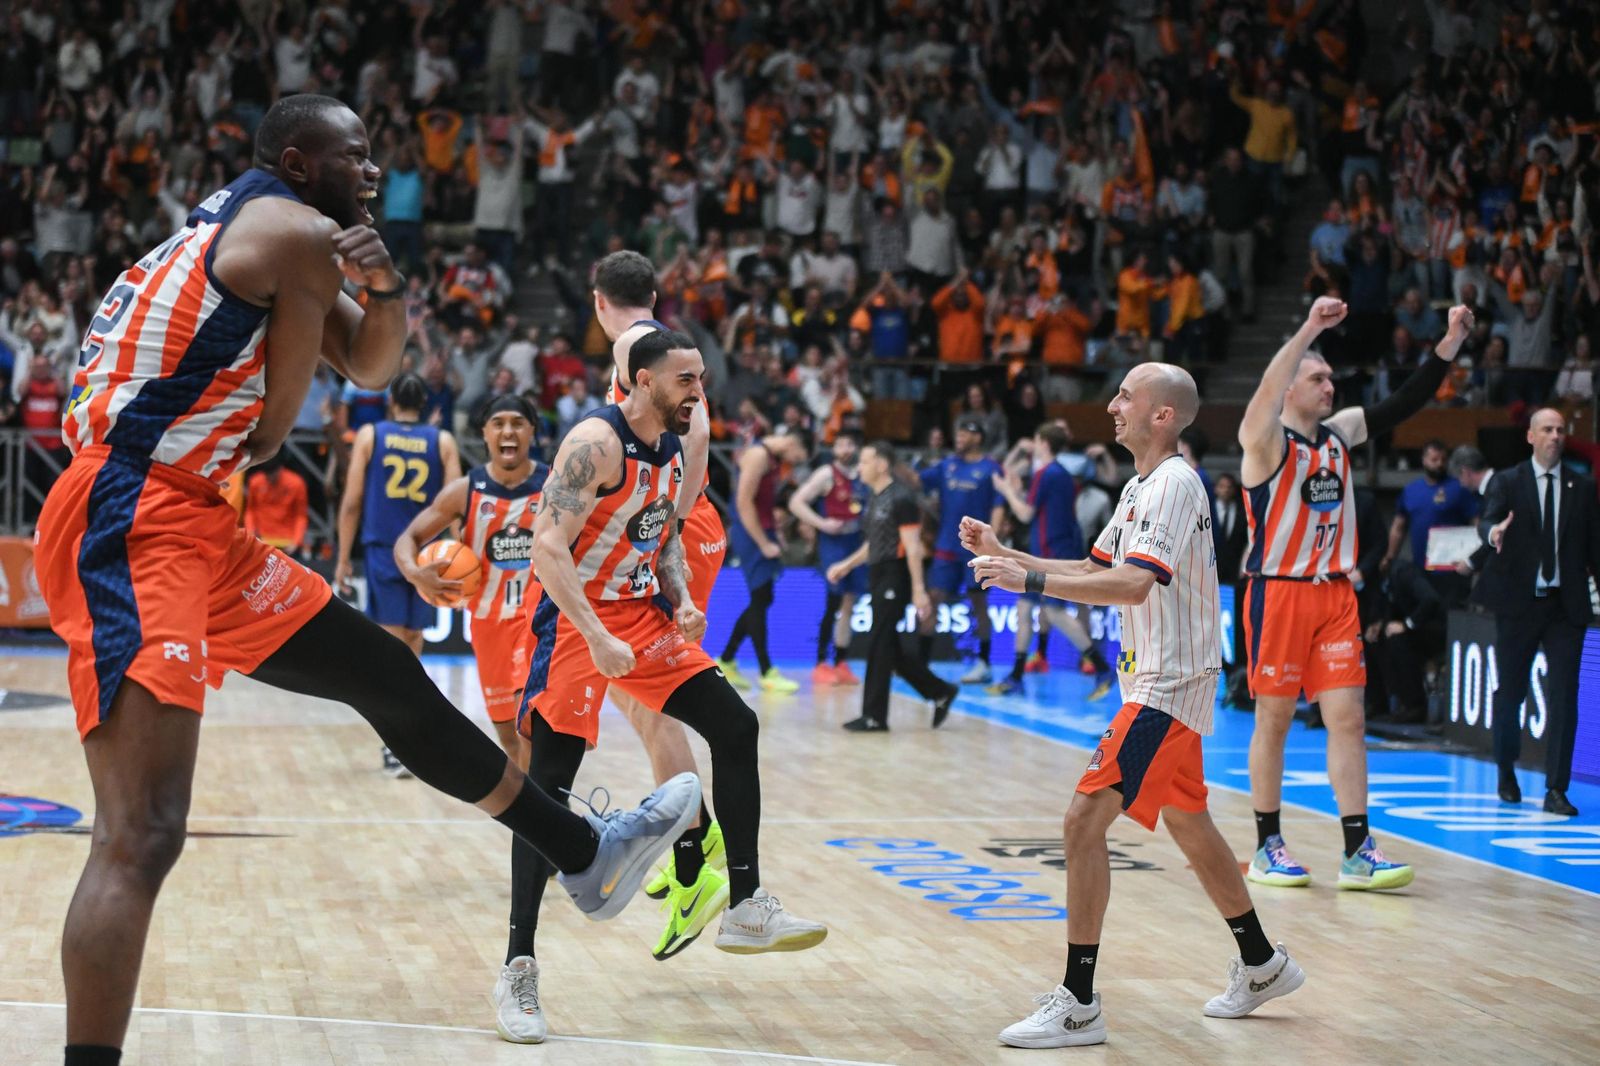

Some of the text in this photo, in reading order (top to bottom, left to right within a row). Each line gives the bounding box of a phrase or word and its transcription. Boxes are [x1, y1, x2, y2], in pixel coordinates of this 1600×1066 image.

[382, 454, 430, 503] 22
[1309, 479, 1339, 492] Estrella
[1311, 490, 1338, 502] Galicia
[1316, 524, 1337, 550] 77
[505, 580, 522, 605] 11
[824, 837, 1067, 921] endesa
